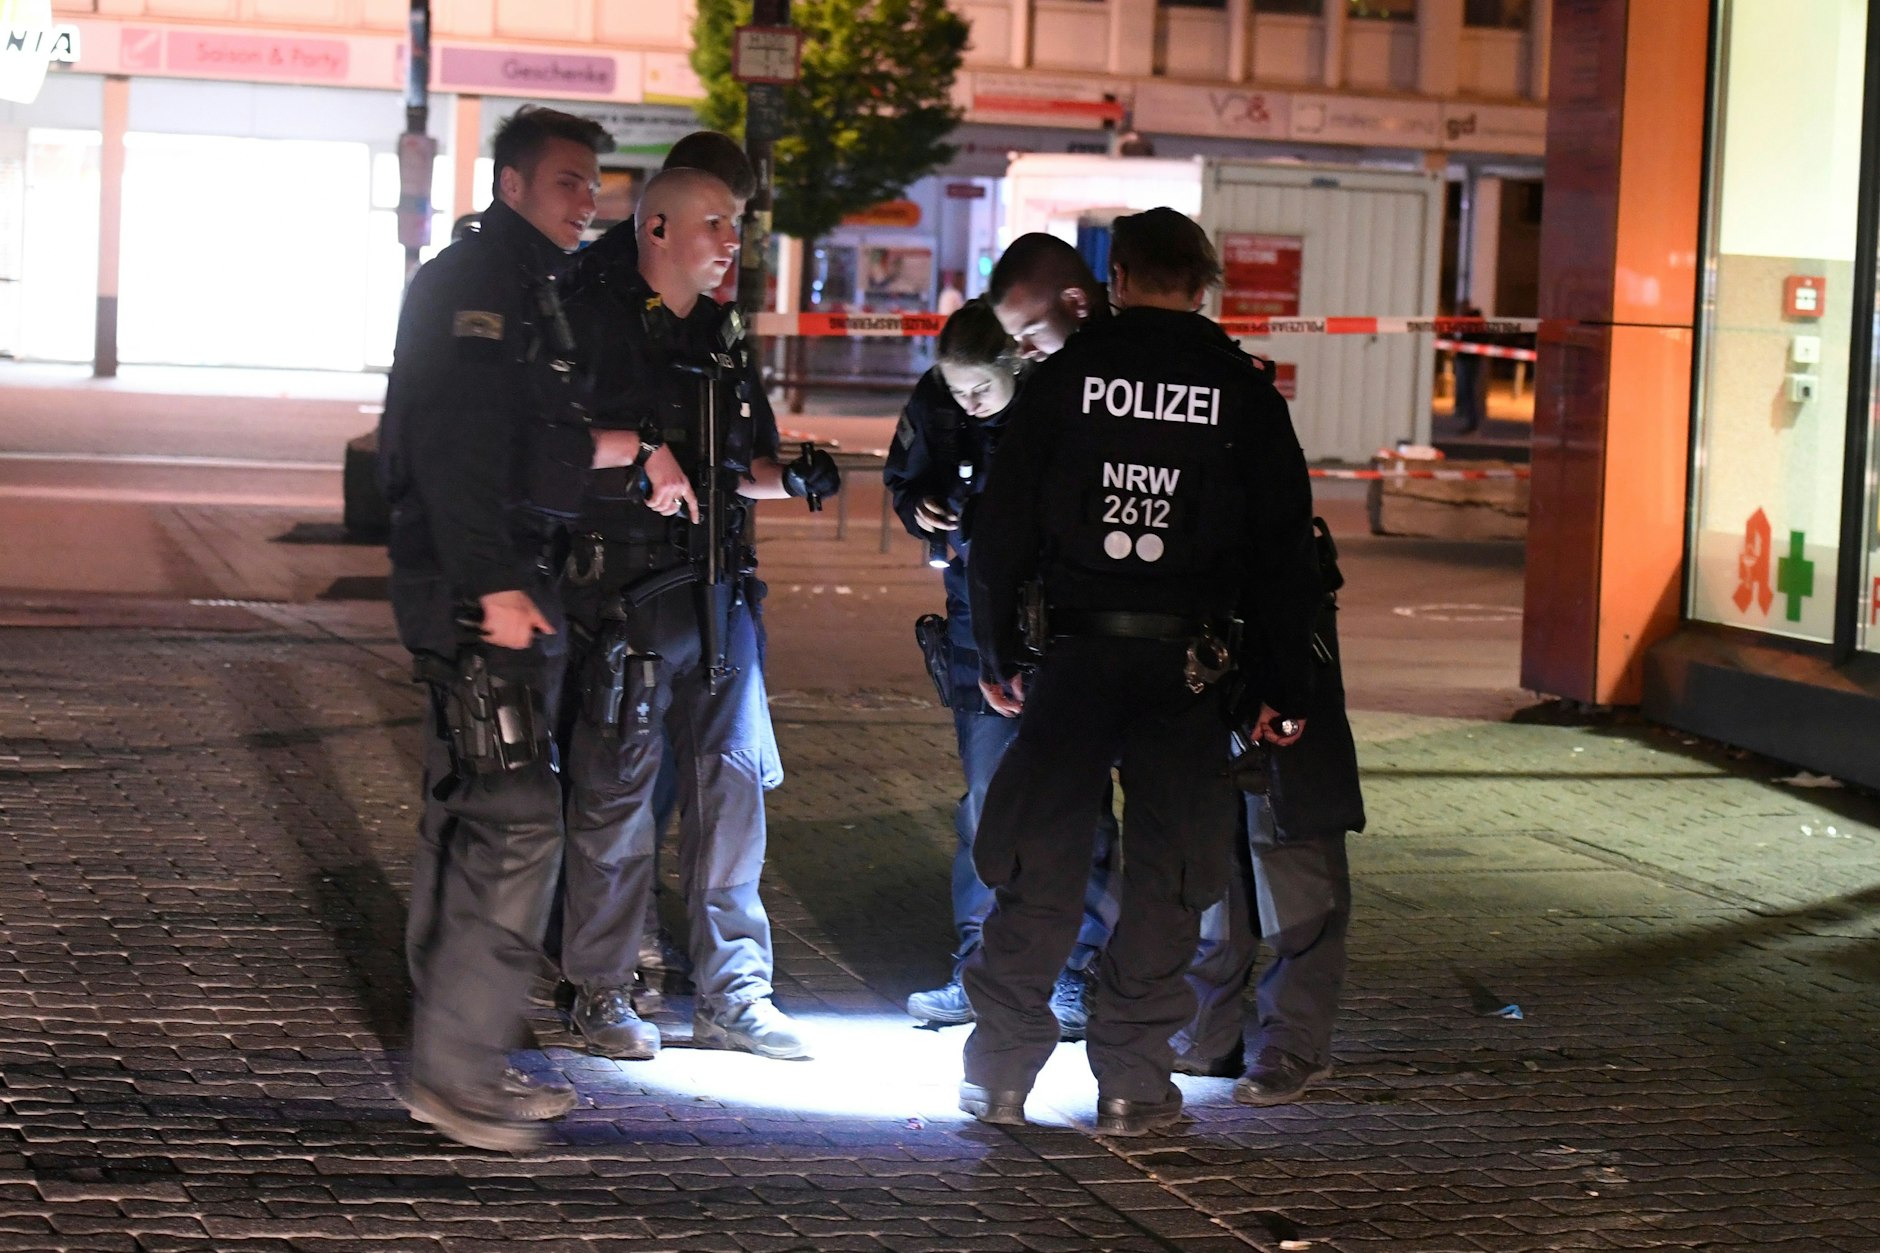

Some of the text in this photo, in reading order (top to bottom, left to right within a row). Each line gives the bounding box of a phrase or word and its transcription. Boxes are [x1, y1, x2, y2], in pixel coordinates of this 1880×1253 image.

[501, 58, 608, 84] Geschenke
[1082, 376, 1220, 426] POLIZEI
[1102, 462, 1181, 496] NRW
[1102, 494, 1171, 528] 2612
